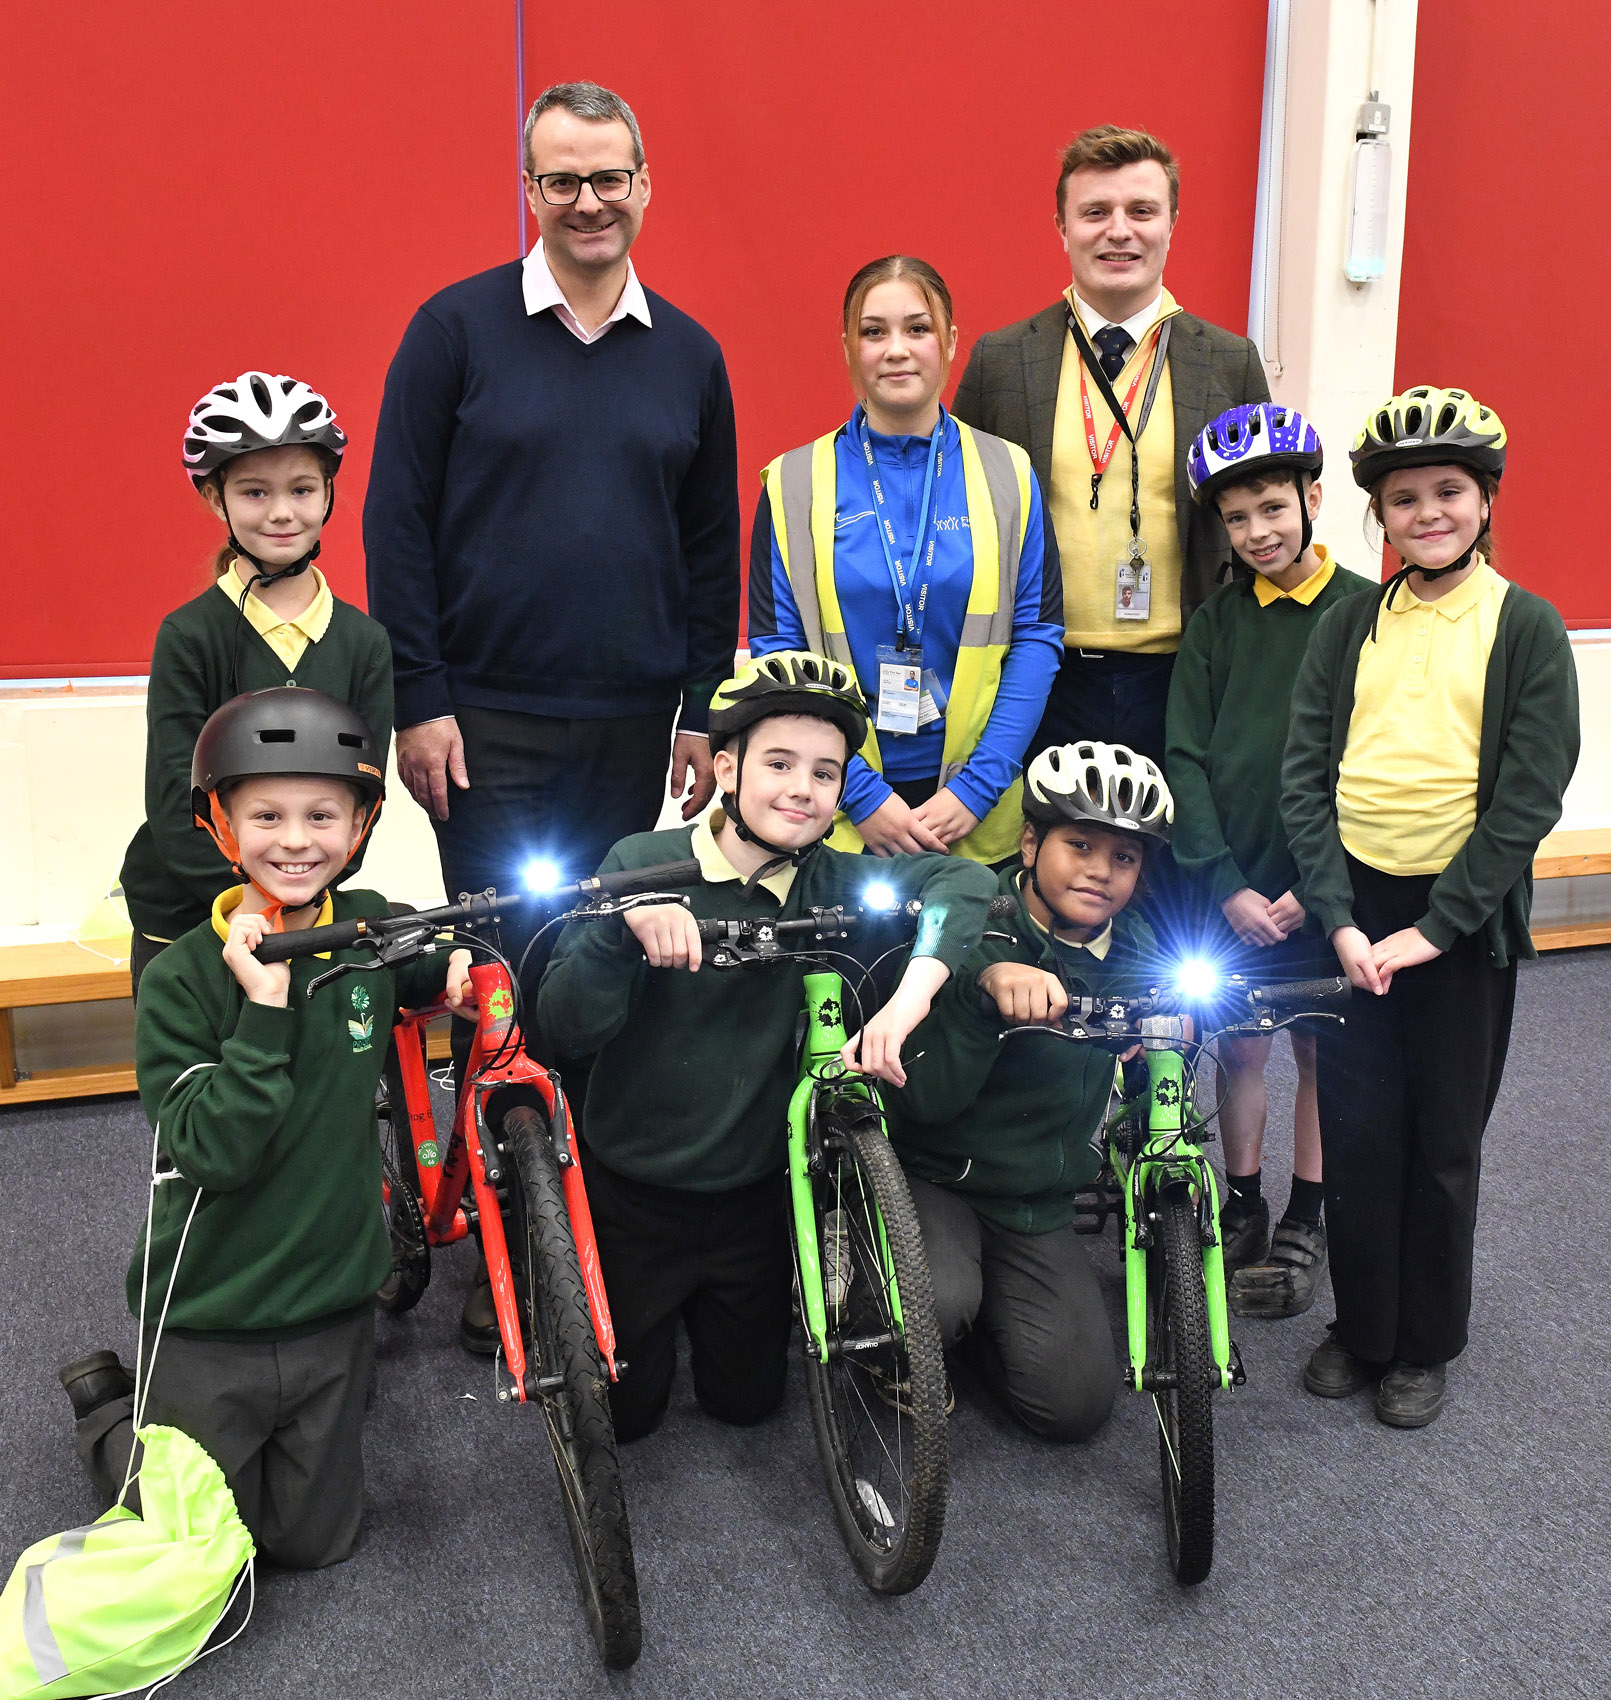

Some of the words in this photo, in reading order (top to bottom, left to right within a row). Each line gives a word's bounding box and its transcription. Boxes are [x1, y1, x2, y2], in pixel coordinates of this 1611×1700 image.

[1083, 395, 1092, 419] VISITOR
[863, 441, 874, 466] VISITOR
[1088, 433, 1098, 460] VISITOR
[1101, 439, 1115, 464] VISITOR
[872, 479, 885, 505] VISITOR
[883, 519, 896, 545] VISITOR
[925, 540, 935, 567] VISITOR
[894, 559, 907, 587] VISITOR
[918, 583, 929, 611] VISITOR
[905, 603, 915, 632] VISITOR
